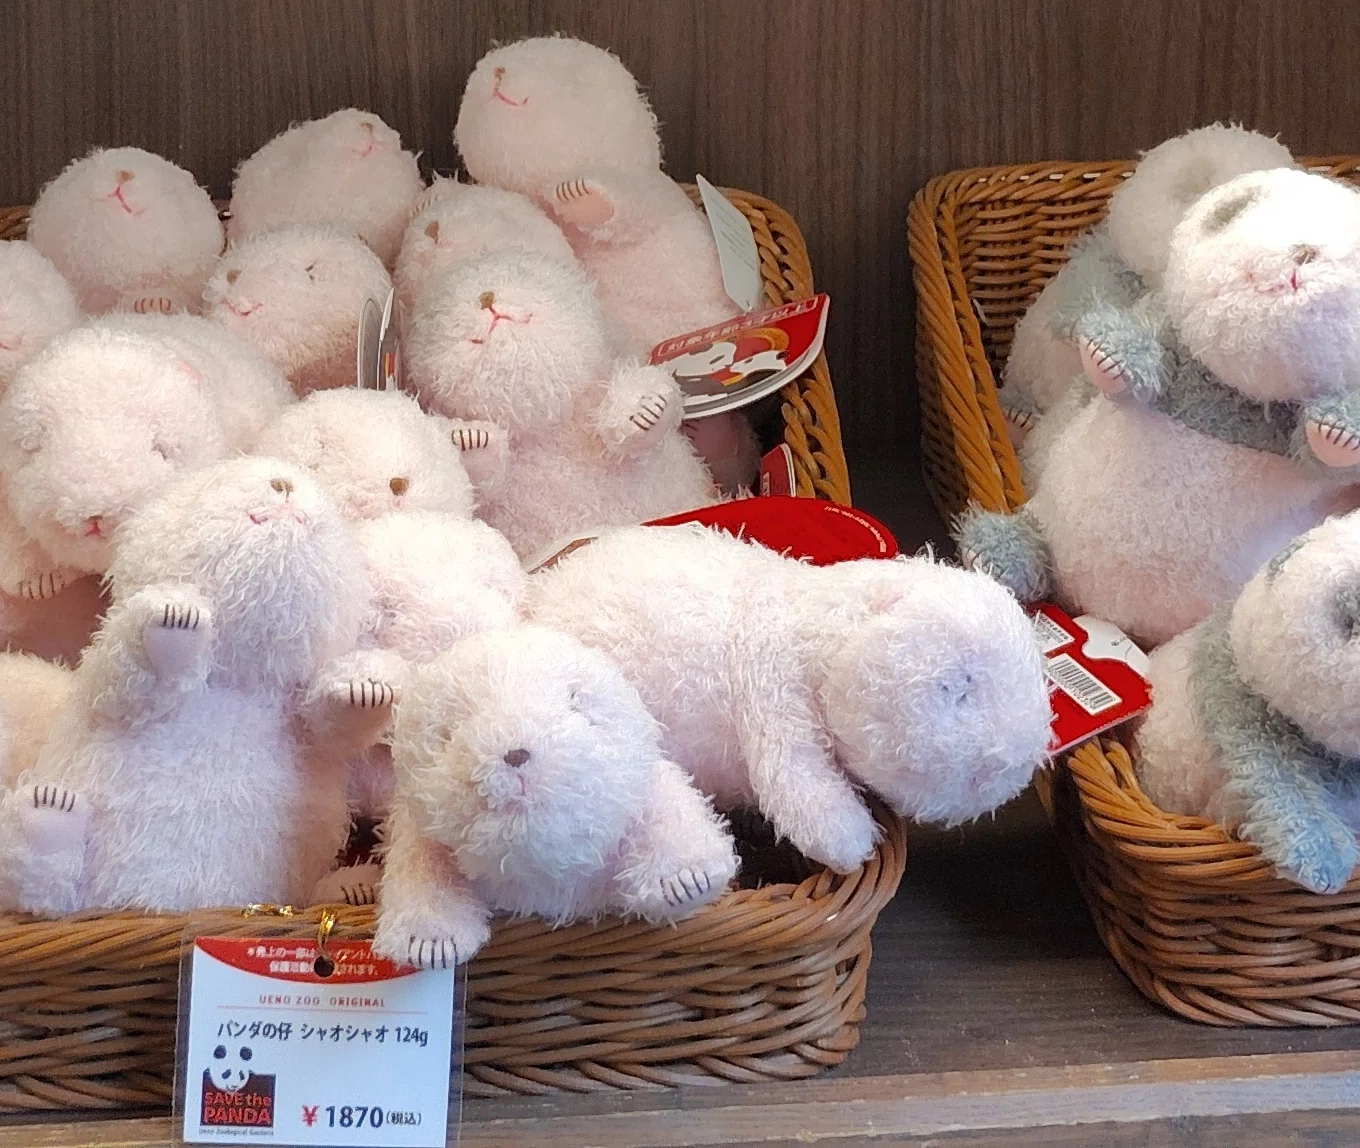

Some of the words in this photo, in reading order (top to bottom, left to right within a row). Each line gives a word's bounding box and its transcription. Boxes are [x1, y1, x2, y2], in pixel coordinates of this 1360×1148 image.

[259, 994, 291, 1005] UENO
[296, 995, 320, 1005] ZOO
[329, 997, 385, 1008] ORIGINAL
[217, 1019, 293, 1041] パンダの仔
[301, 1022, 390, 1043] シャオシャオ
[395, 1026, 429, 1046] 124g
[205, 1092, 244, 1105] SAVE
[245, 1093, 272, 1107] the
[204, 1106, 272, 1125] PANDA
